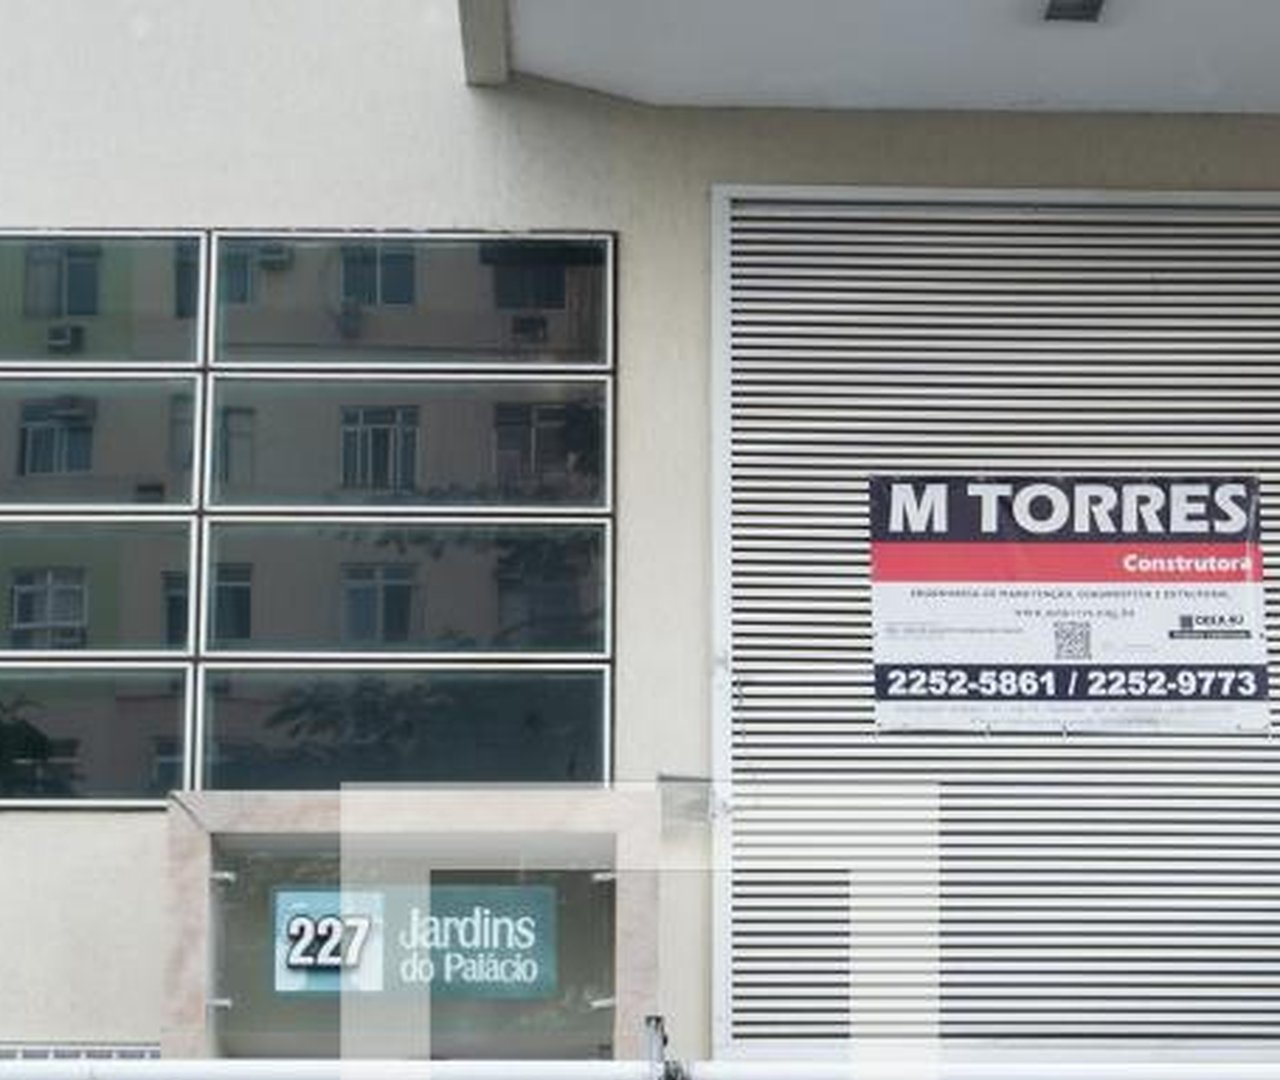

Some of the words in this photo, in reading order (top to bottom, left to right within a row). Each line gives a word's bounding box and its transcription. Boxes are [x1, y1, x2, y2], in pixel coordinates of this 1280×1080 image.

[889, 484, 948, 533] M
[967, 483, 1248, 534] TORRES
[1123, 553, 1252, 572] Construtora
[888, 670, 1056, 696] 2252-5861
[1069, 671, 1078, 697] /
[1087, 670, 1257, 696] 2252-9773
[287, 915, 371, 968] 227
[399, 906, 536, 950] Jardins
[401, 953, 435, 984] do
[444, 952, 539, 984] Palácio
